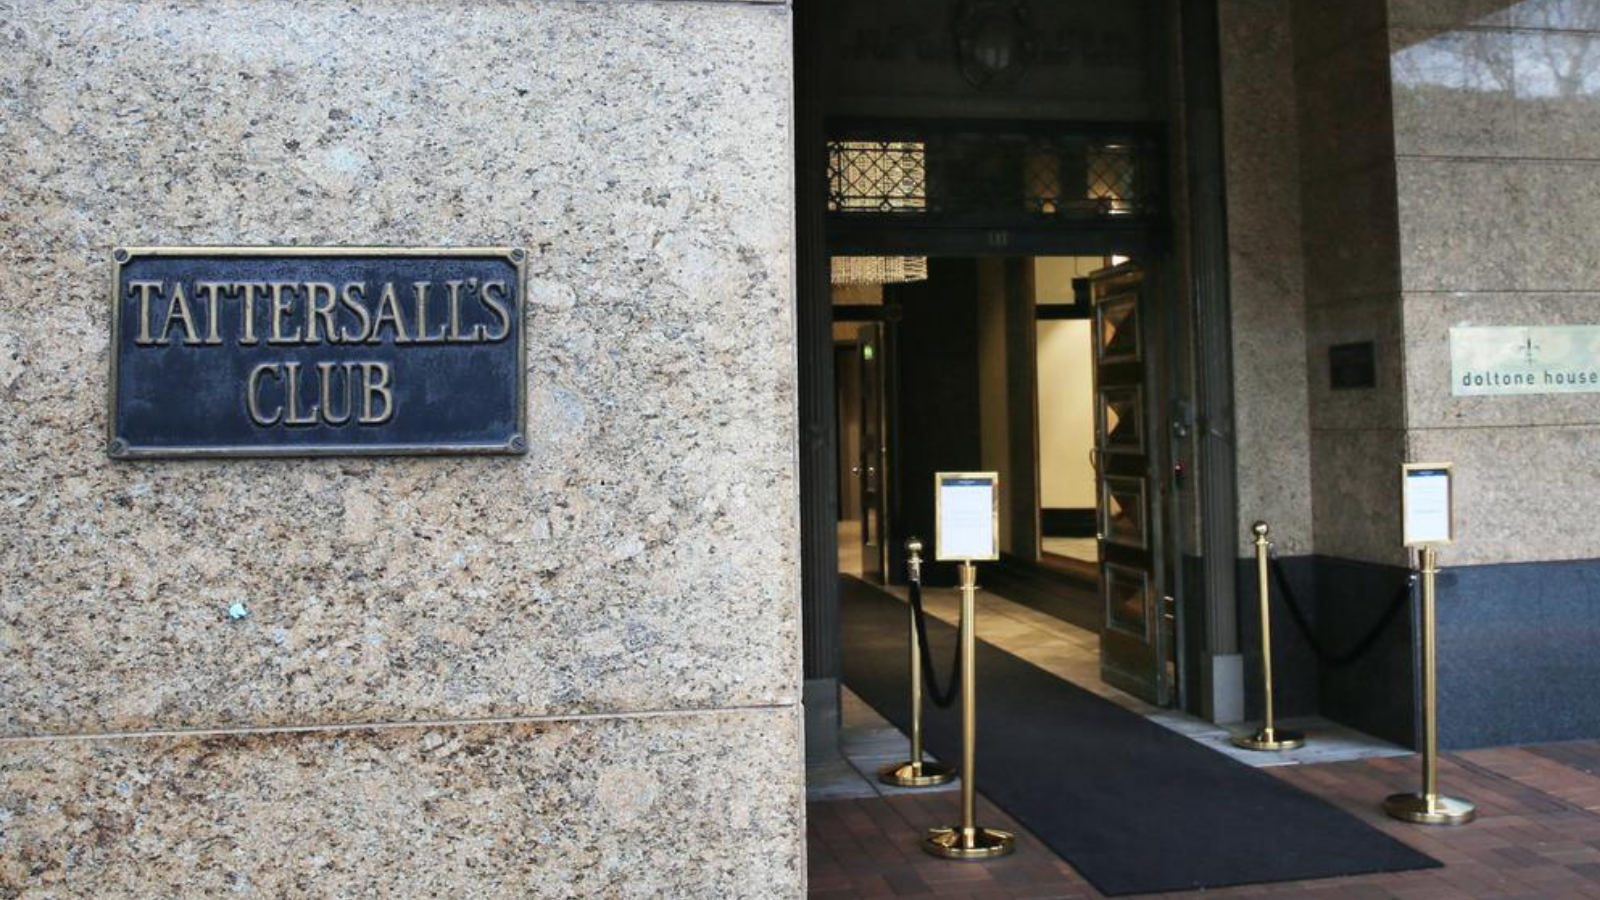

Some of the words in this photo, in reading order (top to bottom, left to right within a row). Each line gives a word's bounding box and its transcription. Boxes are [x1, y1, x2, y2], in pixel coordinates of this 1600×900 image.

[129, 278, 511, 345] TATTERSALL'S
[247, 361, 393, 425] CLUB
[1463, 371, 1535, 387] doltone
[1544, 370, 1598, 385] house
